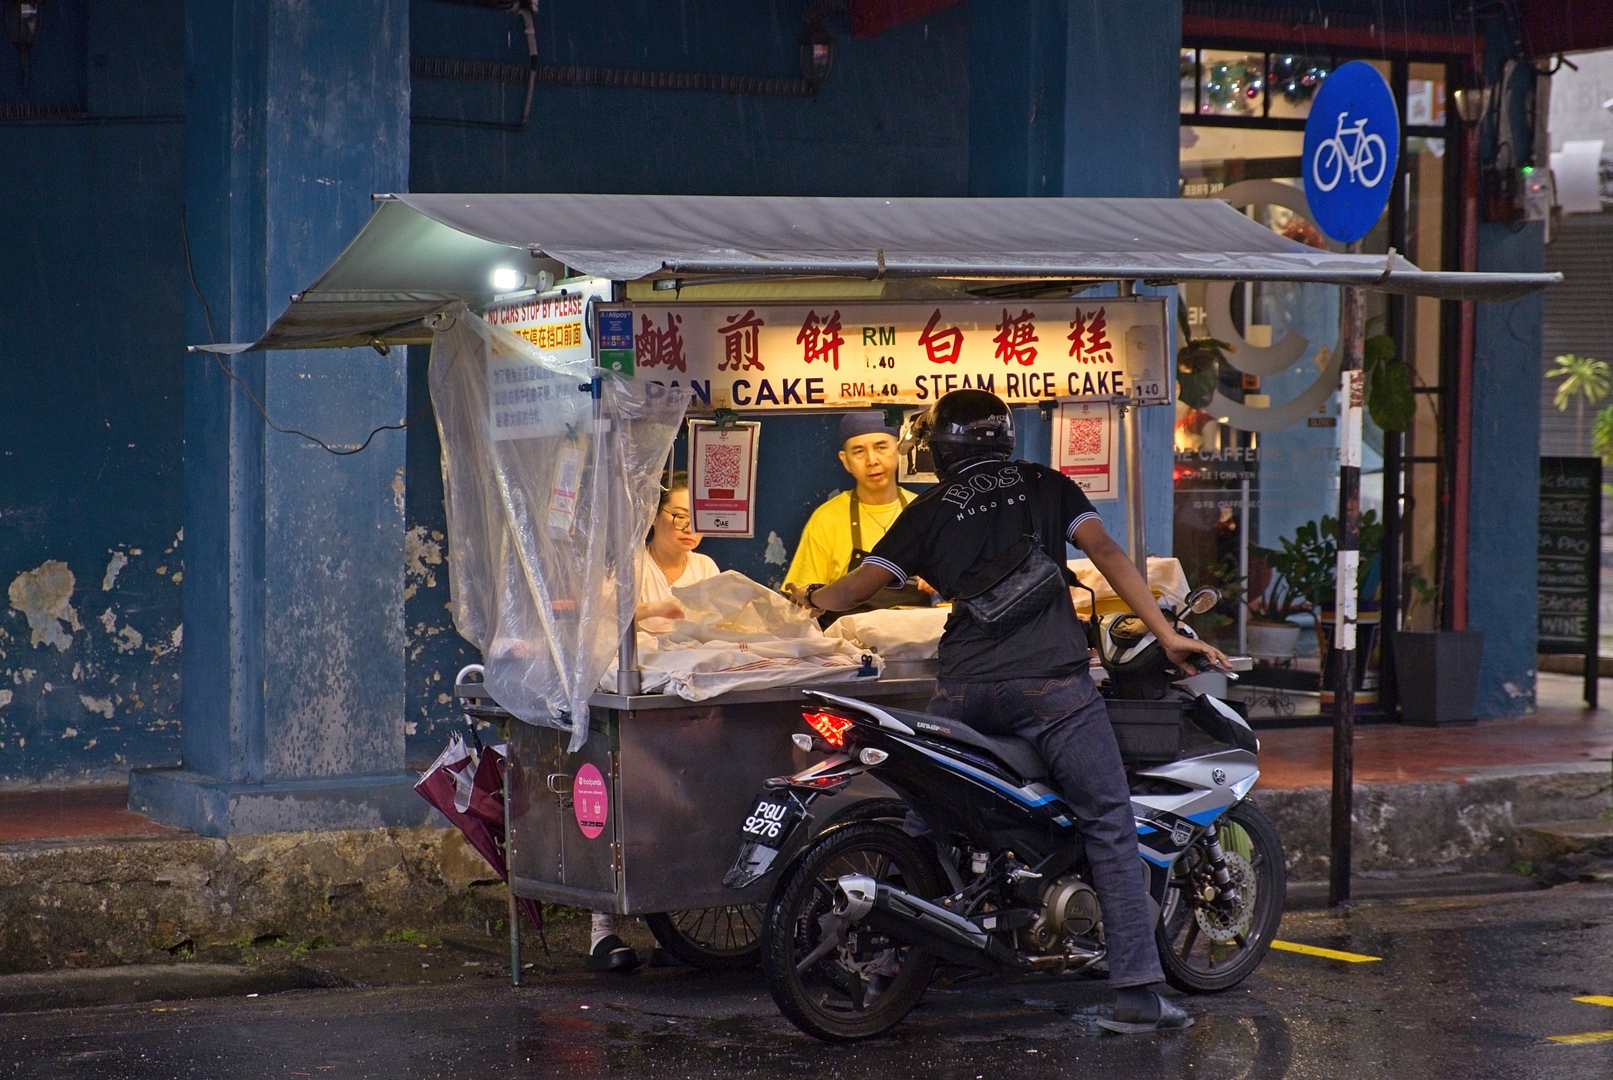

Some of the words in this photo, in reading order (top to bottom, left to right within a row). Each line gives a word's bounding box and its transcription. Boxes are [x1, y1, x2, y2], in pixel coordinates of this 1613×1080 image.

[488, 309, 498, 325] NO
[500, 305, 519, 324] CARS
[521, 300, 539, 321] STOP
[542, 298, 552, 319] BY
[555, 295, 582, 317] PLEASE
[635, 309, 845, 372] 鹹煎餅
[863, 326, 896, 346] RM
[918, 307, 1113, 366] 白糖糕
[866, 356, 895, 369] 1.40
[644, 379, 711, 407] PAN
[732, 377, 825, 406] CAKE
[841, 382, 866, 397] RM
[868, 383, 898, 397] 1.40
[915, 373, 995, 400] STEAM
[1006, 372, 1056, 398] RICE
[1068, 370, 1124, 396] CAKE
[956, 501, 997, 521] HUGO
[582, 777, 602, 787] foodpanda
[754, 801, 787, 820] PQU
[742, 816, 782, 838] 9276
